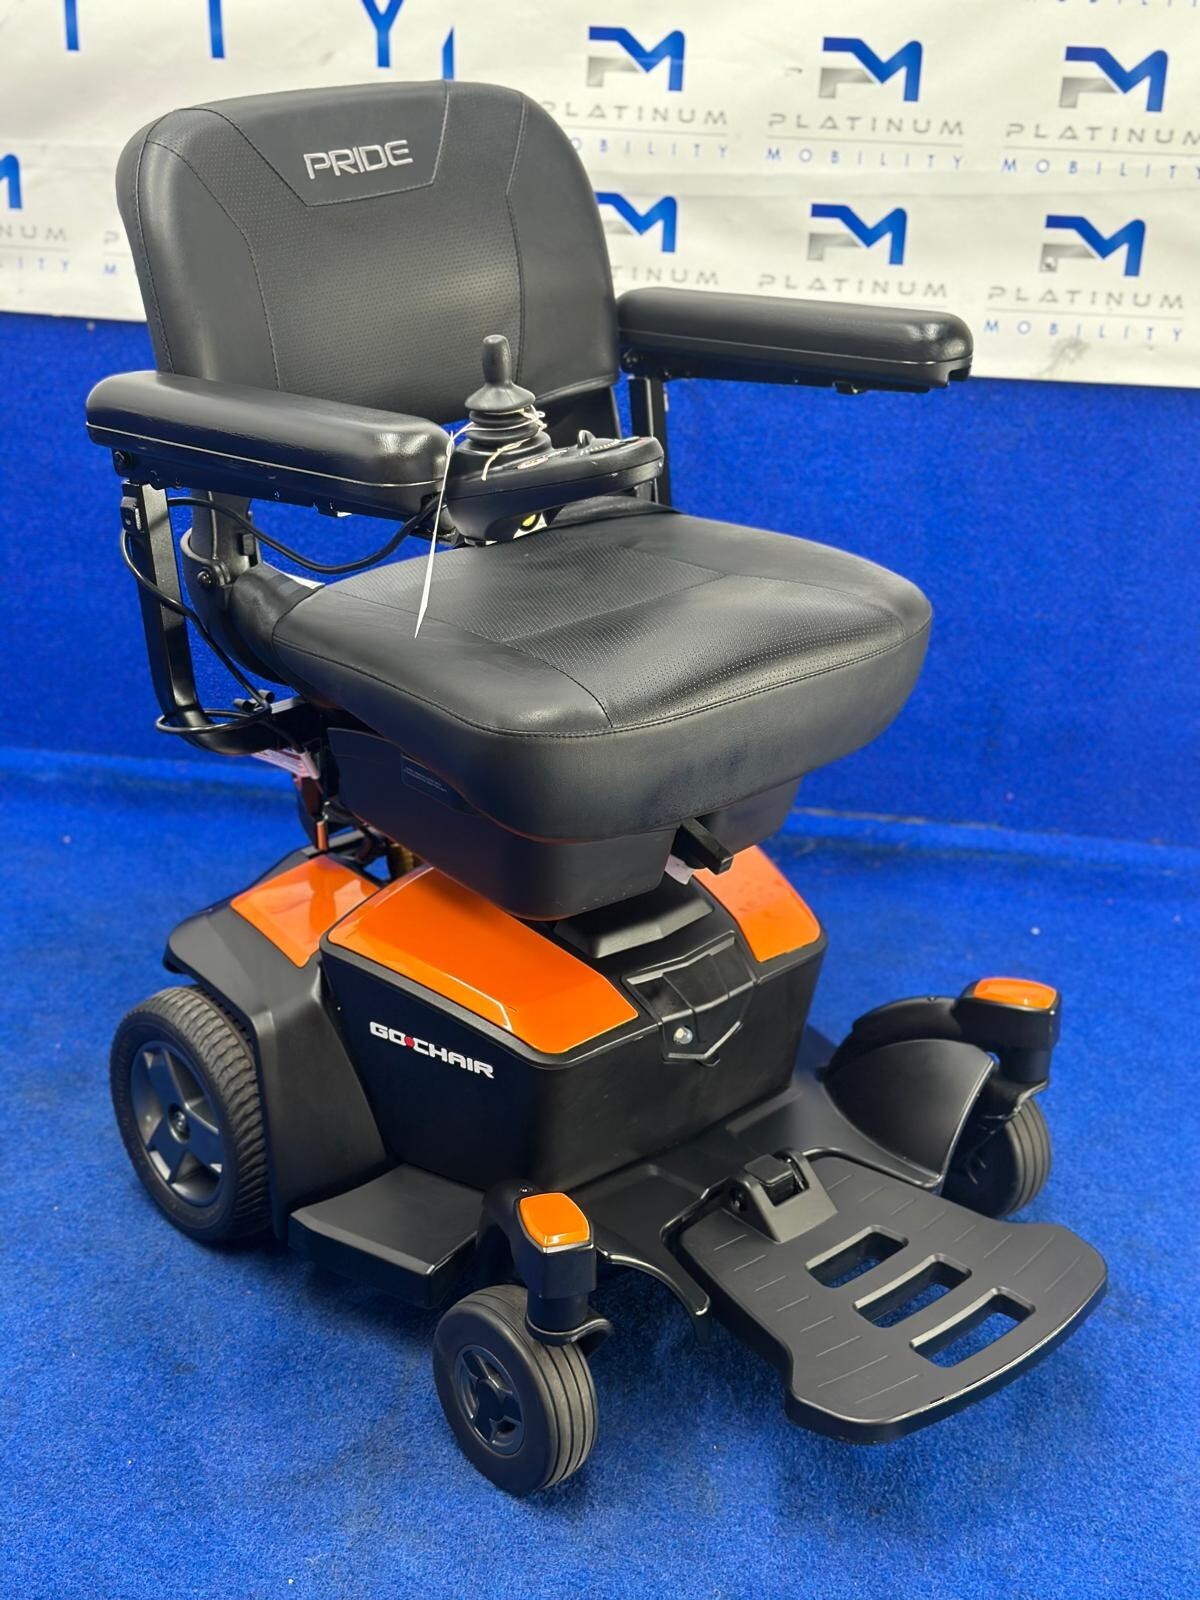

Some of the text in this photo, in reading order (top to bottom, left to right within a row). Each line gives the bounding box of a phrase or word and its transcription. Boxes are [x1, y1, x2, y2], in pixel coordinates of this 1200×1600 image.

[542, 100, 728, 126] PLATINUM
[768, 113, 964, 135] PLATINUM
[1006, 123, 1200, 146] PLATINUM
[571, 136, 727, 158] OBILITY
[303, 139, 414, 180] PRIDE
[766, 148, 962, 169] MOBILITY
[611, 265, 719, 287] TINUM
[757, 273, 948, 299] PLATINUM
[988, 286, 1184, 309] PLATINUM
[984, 320, 1182, 342] MOBILITY
